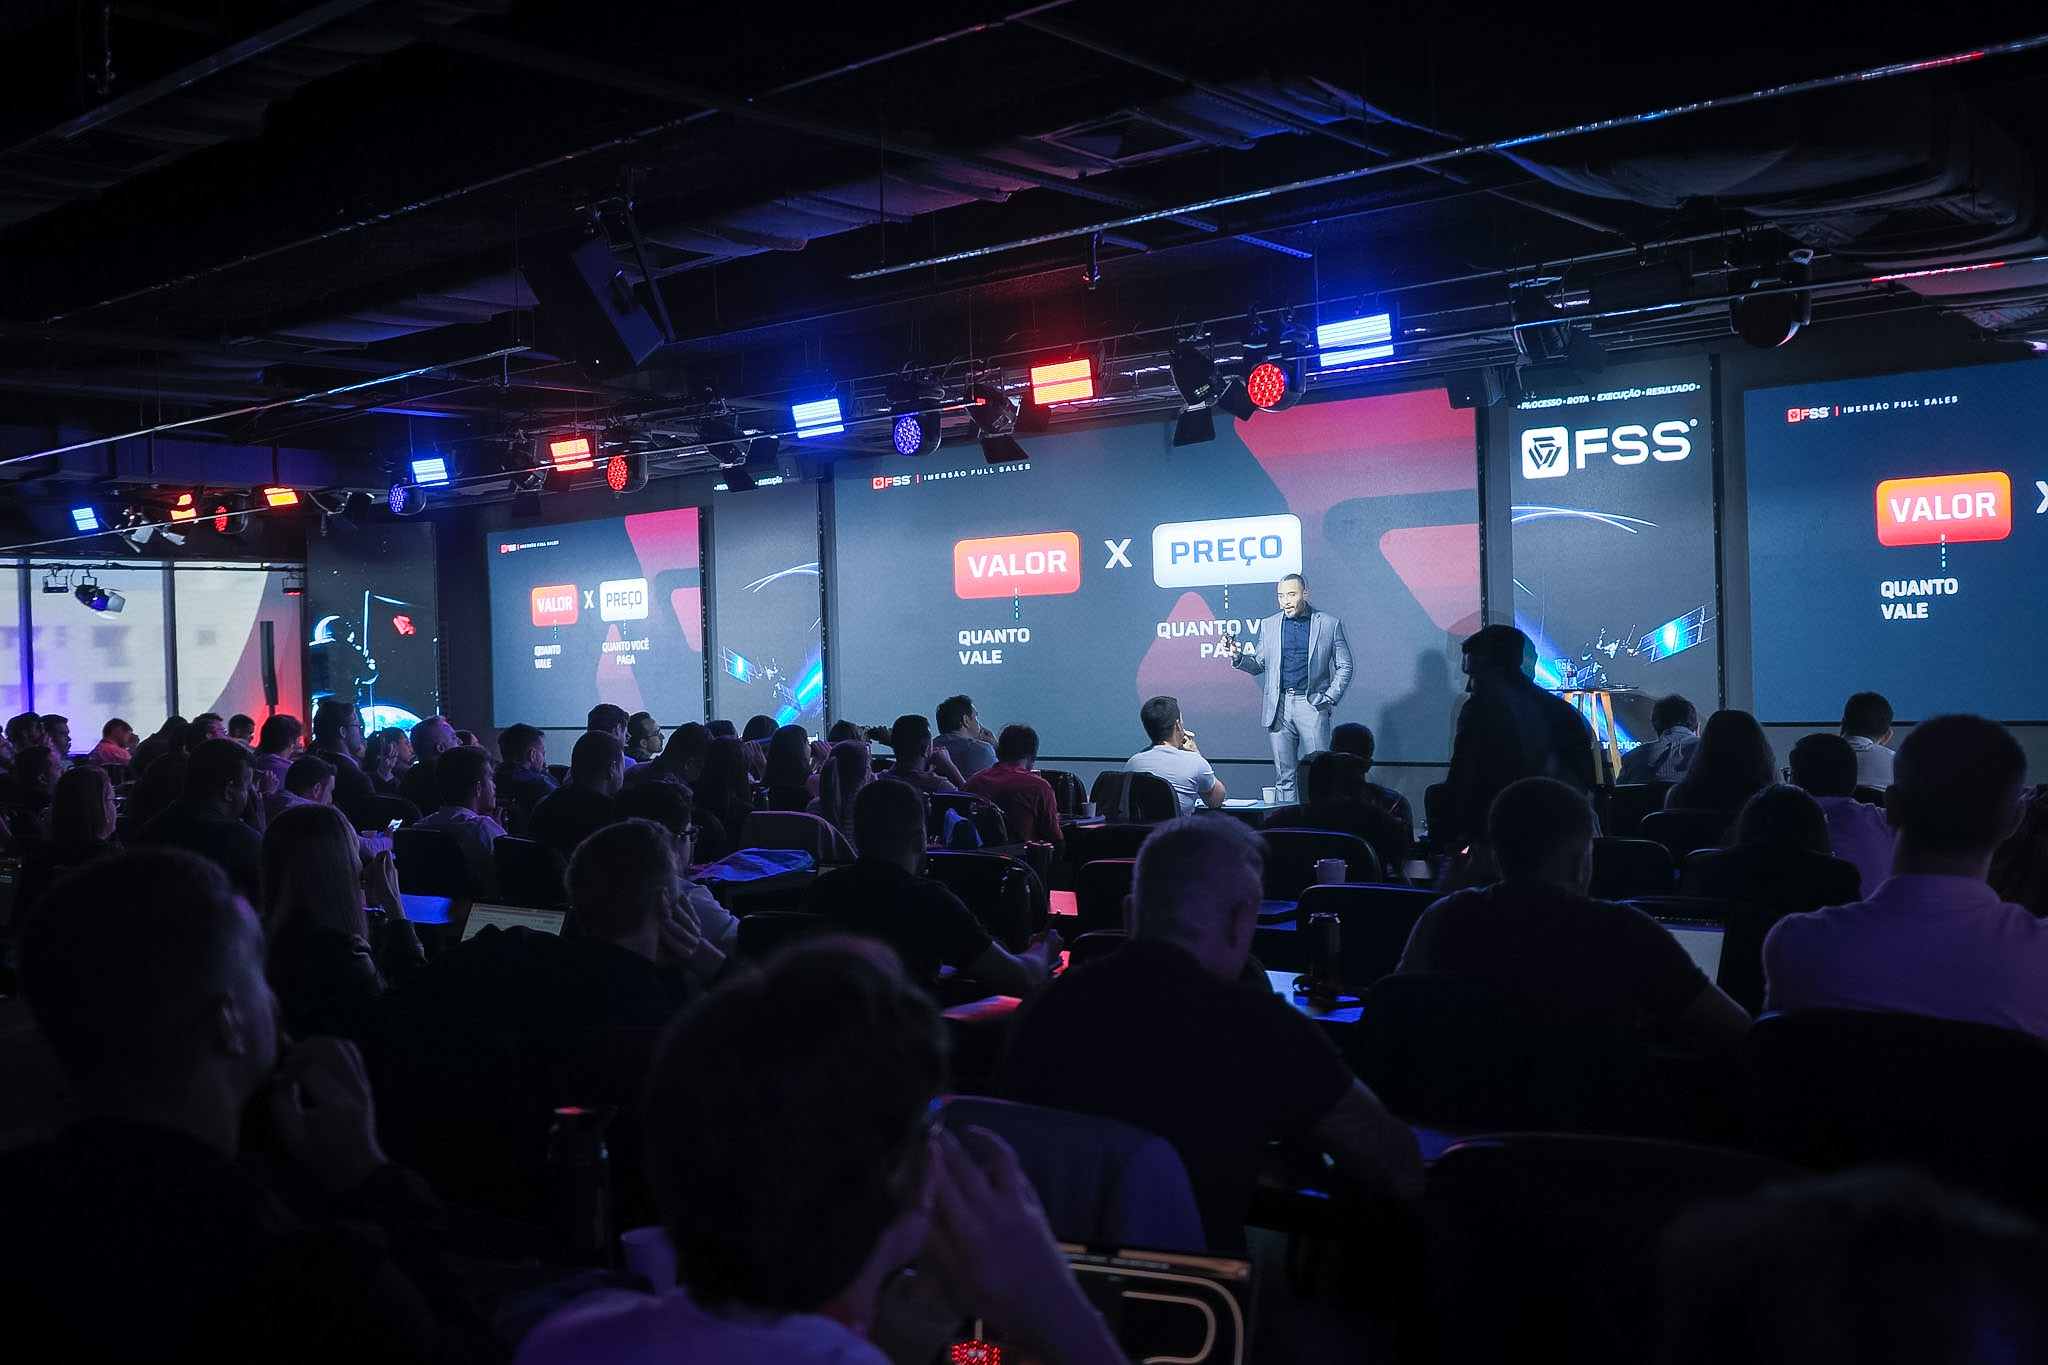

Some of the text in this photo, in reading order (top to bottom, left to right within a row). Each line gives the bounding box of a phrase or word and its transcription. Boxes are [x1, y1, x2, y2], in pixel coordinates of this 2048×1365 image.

[1567, 395, 1590, 405] ROTA
[1597, 387, 1641, 401] EXECUÇÃO
[1646, 383, 1696, 396] RESULTADO
[1800, 395, 1959, 420] FSS IMERSÃO FULL SALES
[884, 463, 1031, 488] FSS IMERSÃO FULL SALES
[1889, 491, 1997, 523] VALOR
[967, 535, 1282, 578] VALOR X PREÇO
[1880, 577, 1959, 600] QUANTO
[536, 589, 642, 613] VALOR X PREÇO
[1880, 602, 1929, 620] VALE
[958, 627, 1031, 647] QUANTO
[1156, 618, 1242, 640] QUANTO
[602, 637, 650, 653] QUANTO VOCÊ
[616, 654, 636, 665] PAGA
[958, 650, 1003, 665] VALE
